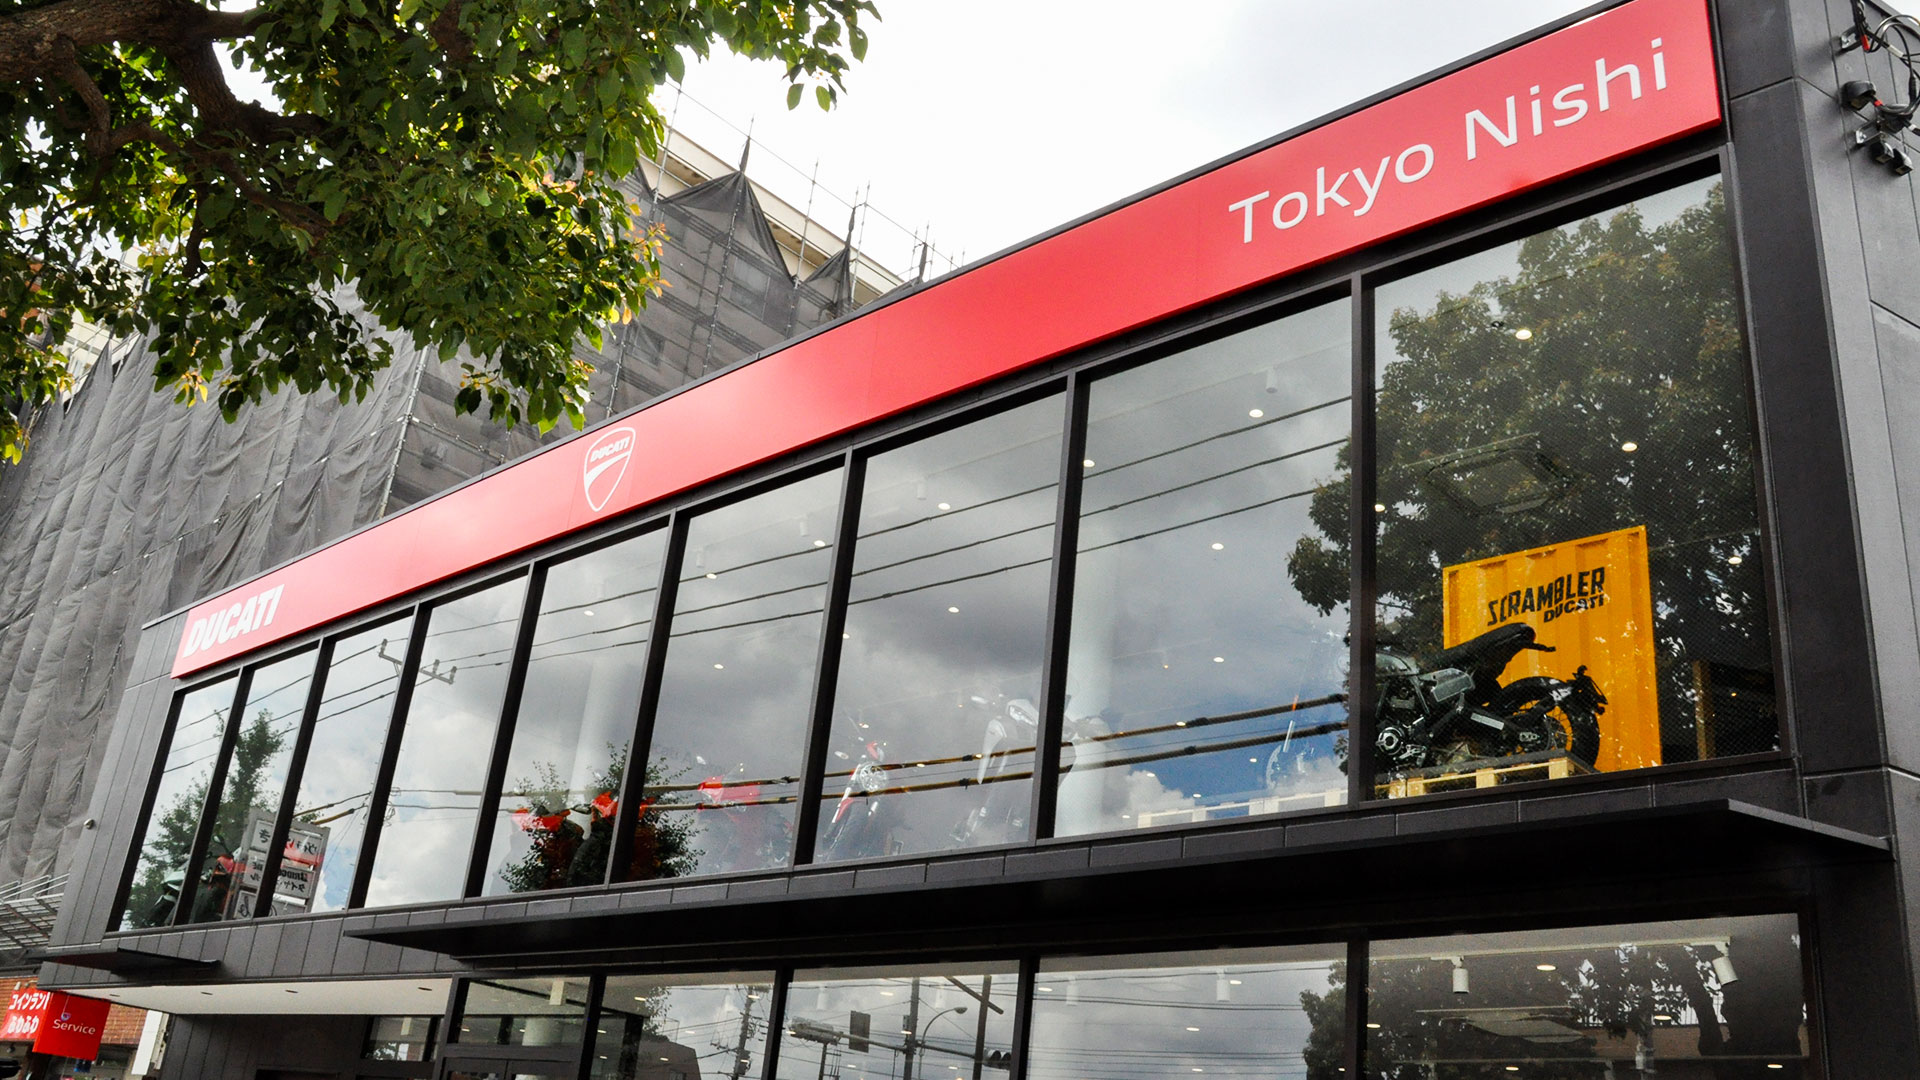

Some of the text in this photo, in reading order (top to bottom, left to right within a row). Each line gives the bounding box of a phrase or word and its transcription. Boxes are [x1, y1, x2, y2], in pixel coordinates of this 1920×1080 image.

[1228, 37, 1668, 244] Tokyo Nishi
[590, 436, 631, 463] DUCATI
[1487, 566, 1606, 627] SCRAMBLER
[1543, 593, 1605, 623] DUCATI
[182, 583, 285, 659] DUCATI
[52, 1019, 96, 1035] Service
